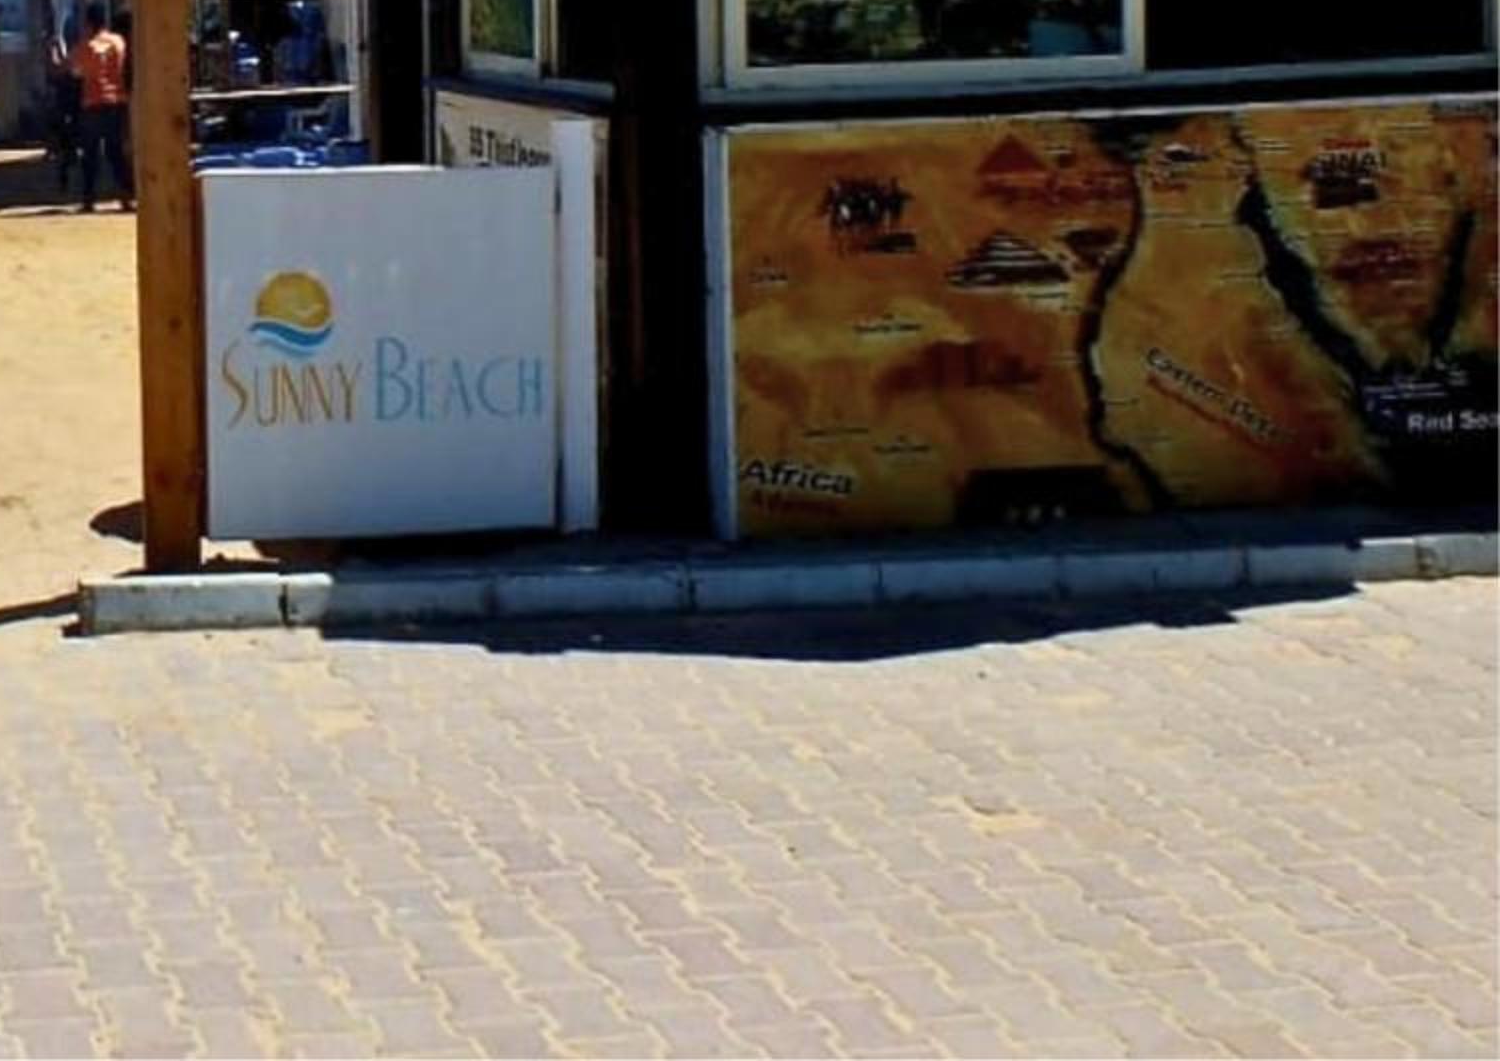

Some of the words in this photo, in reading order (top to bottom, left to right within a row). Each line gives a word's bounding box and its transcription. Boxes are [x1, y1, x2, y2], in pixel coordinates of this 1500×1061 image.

[220, 339, 361, 429] SUNNY
[375, 335, 544, 422] BEACH
[740, 458, 853, 495] Africa
